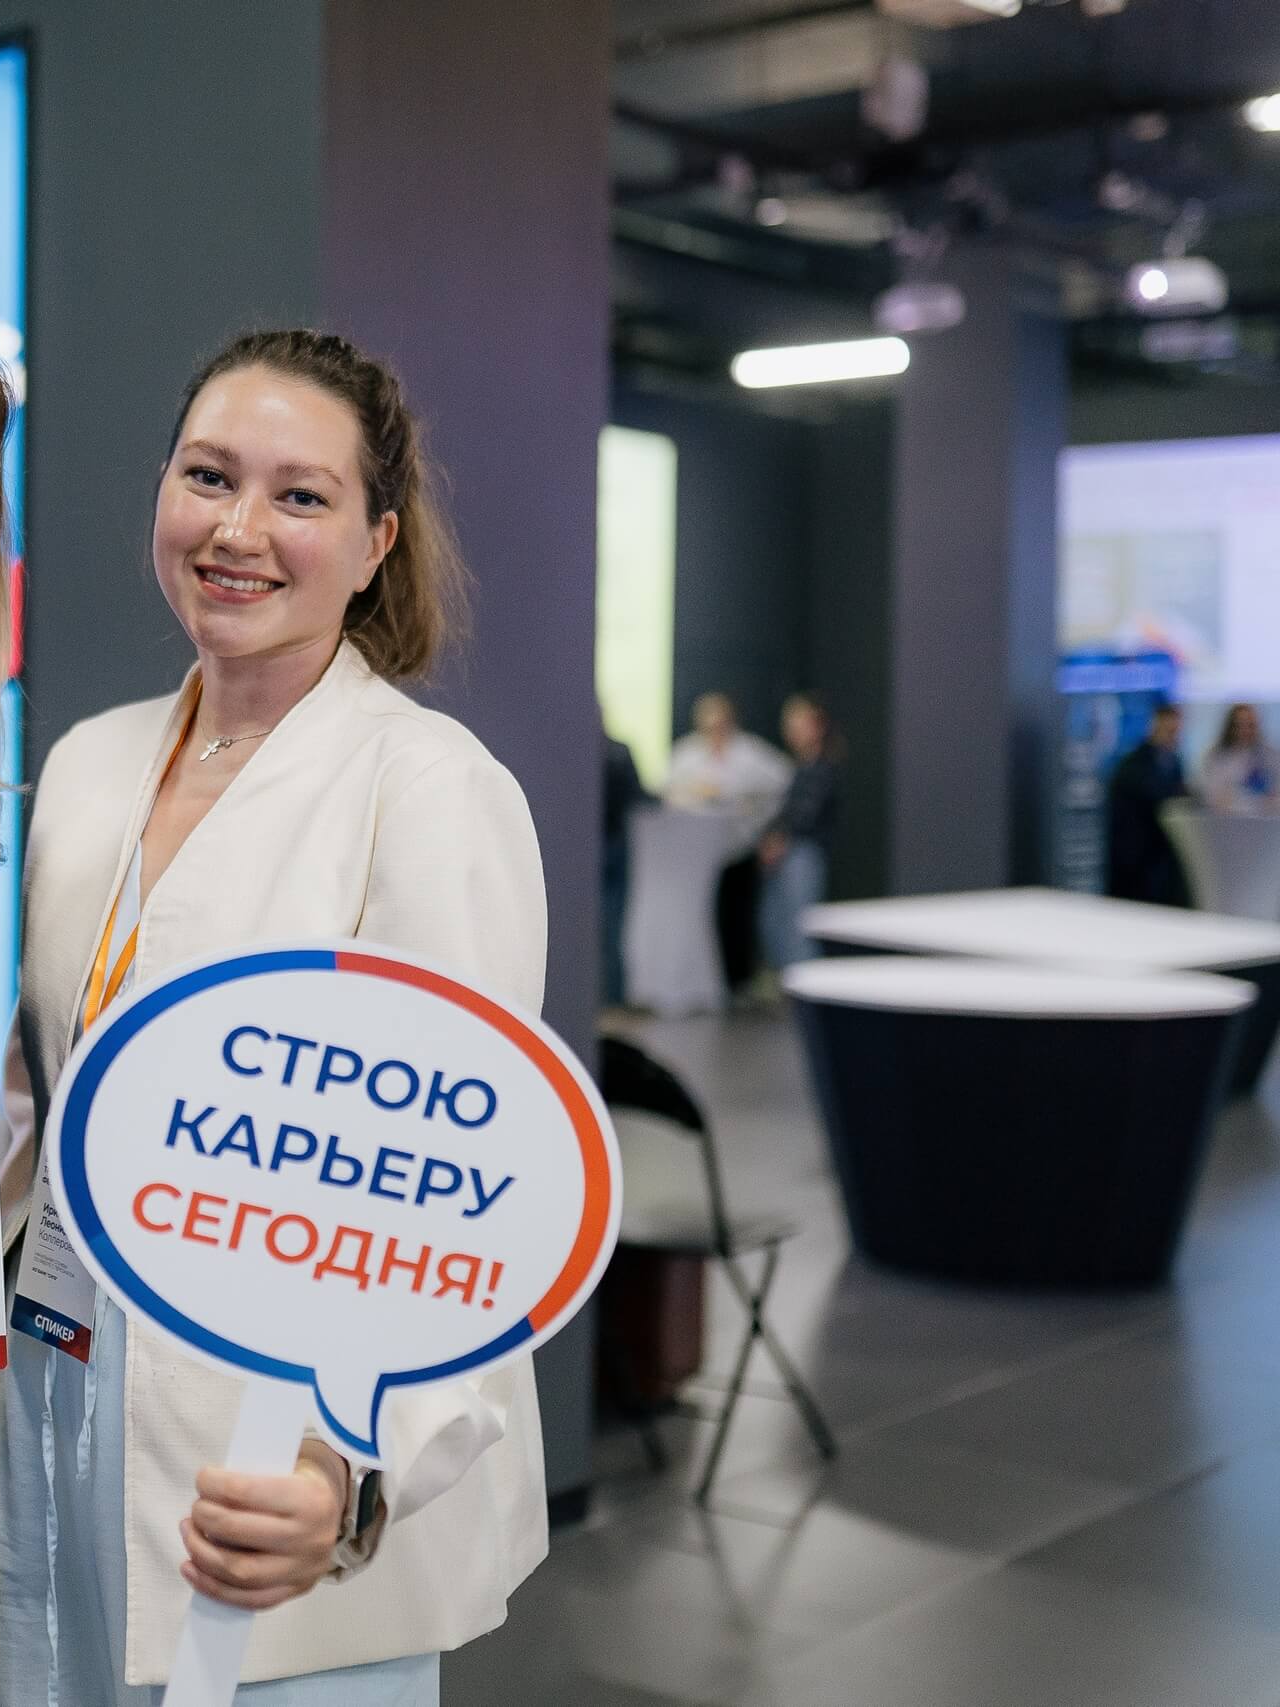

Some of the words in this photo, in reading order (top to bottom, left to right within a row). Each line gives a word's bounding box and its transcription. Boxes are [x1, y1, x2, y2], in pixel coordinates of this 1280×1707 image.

[222, 1026, 497, 1129] СТРОЮ
[166, 1099, 512, 1217] КАРЬЕРУ
[132, 1183, 504, 1309] СЕГОДНЯ!
[34, 1314, 75, 1343] СПИКЕР
